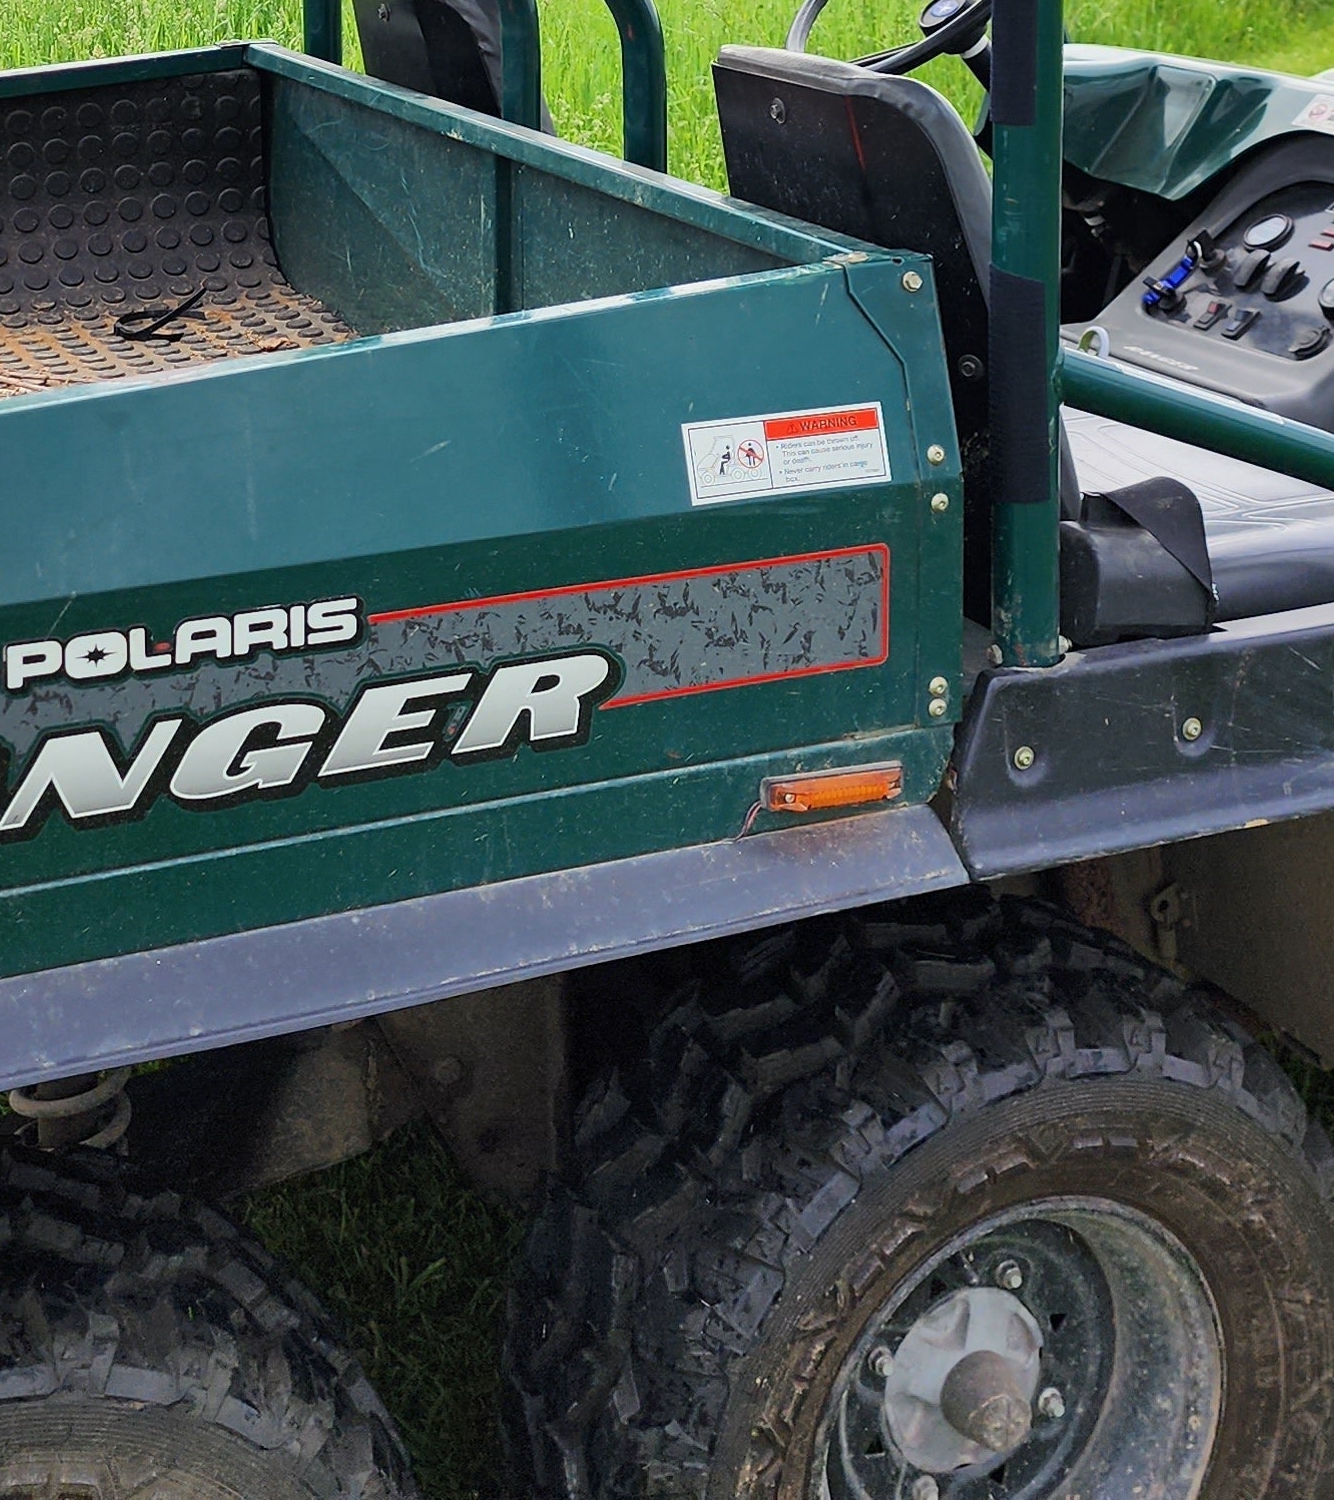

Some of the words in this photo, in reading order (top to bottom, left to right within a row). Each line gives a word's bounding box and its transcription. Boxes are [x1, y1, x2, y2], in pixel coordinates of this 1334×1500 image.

[799, 416, 857, 431] WARNING
[780, 441, 802, 449] Riders
[782, 449, 796, 457] This
[832, 443, 855, 451] serious
[856, 442, 873, 450] injury
[784, 467, 803, 475] Never
[804, 465, 821, 473] carry
[4, 596, 359, 690] POLARIS
